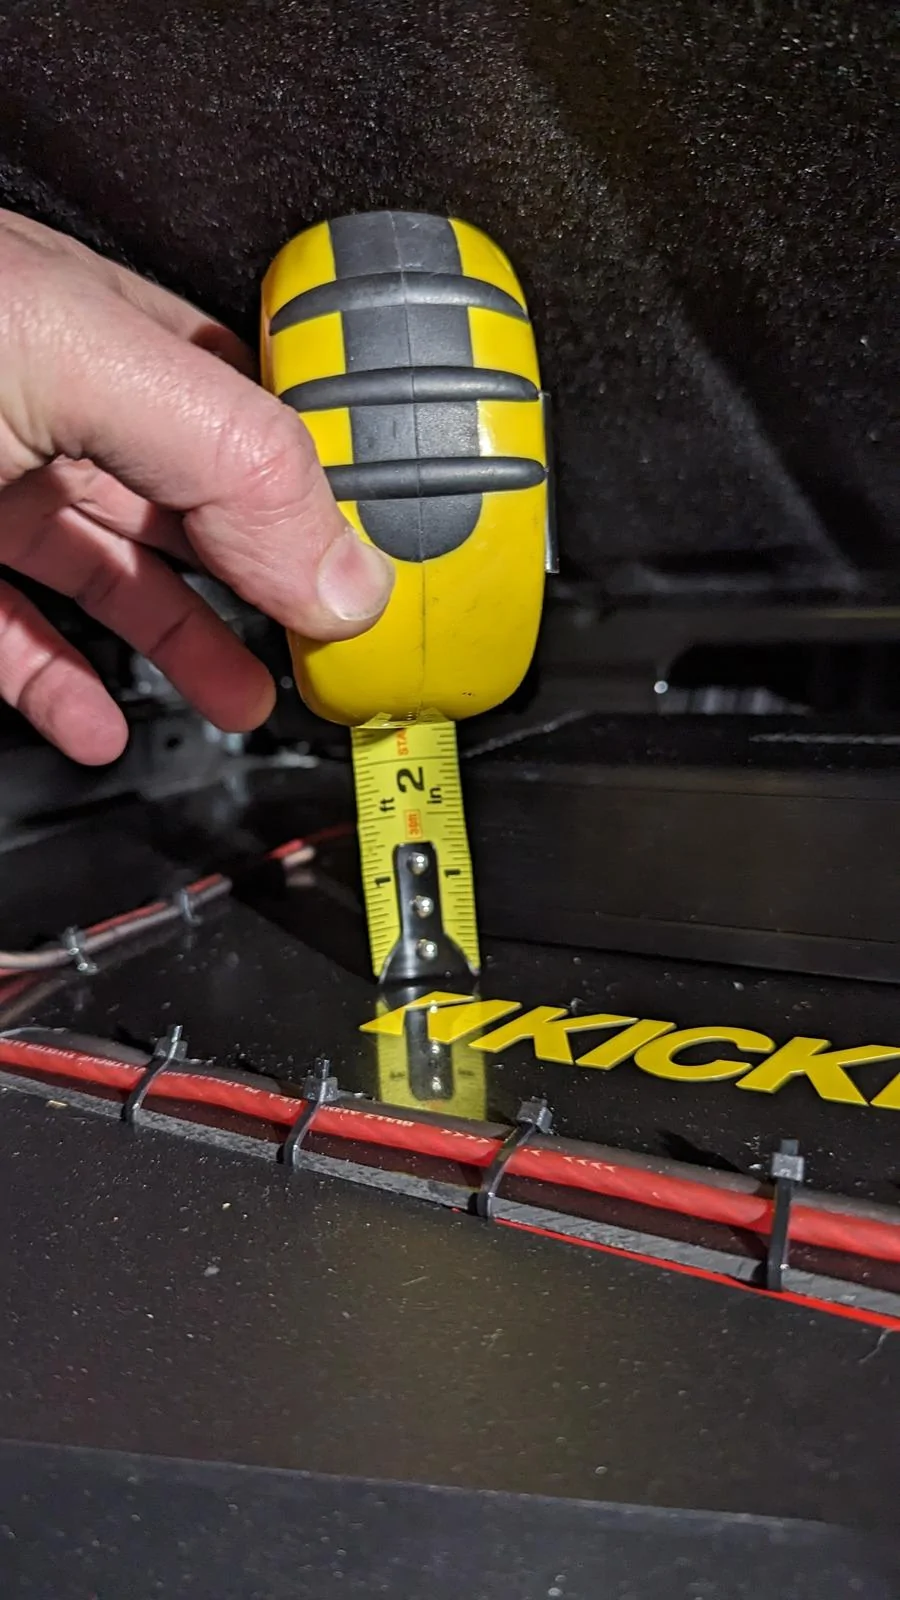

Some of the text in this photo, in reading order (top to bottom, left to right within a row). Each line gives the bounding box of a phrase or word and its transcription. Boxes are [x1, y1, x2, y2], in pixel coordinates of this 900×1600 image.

[397, 728, 409, 756] STA
[396, 766, 425, 793] 2
[427, 786, 443, 804] in
[380, 797, 395, 812] ft
[375, 877, 391, 888] 1
[445, 869, 461, 878] 1
[469, 1005, 900, 1109] KICK
